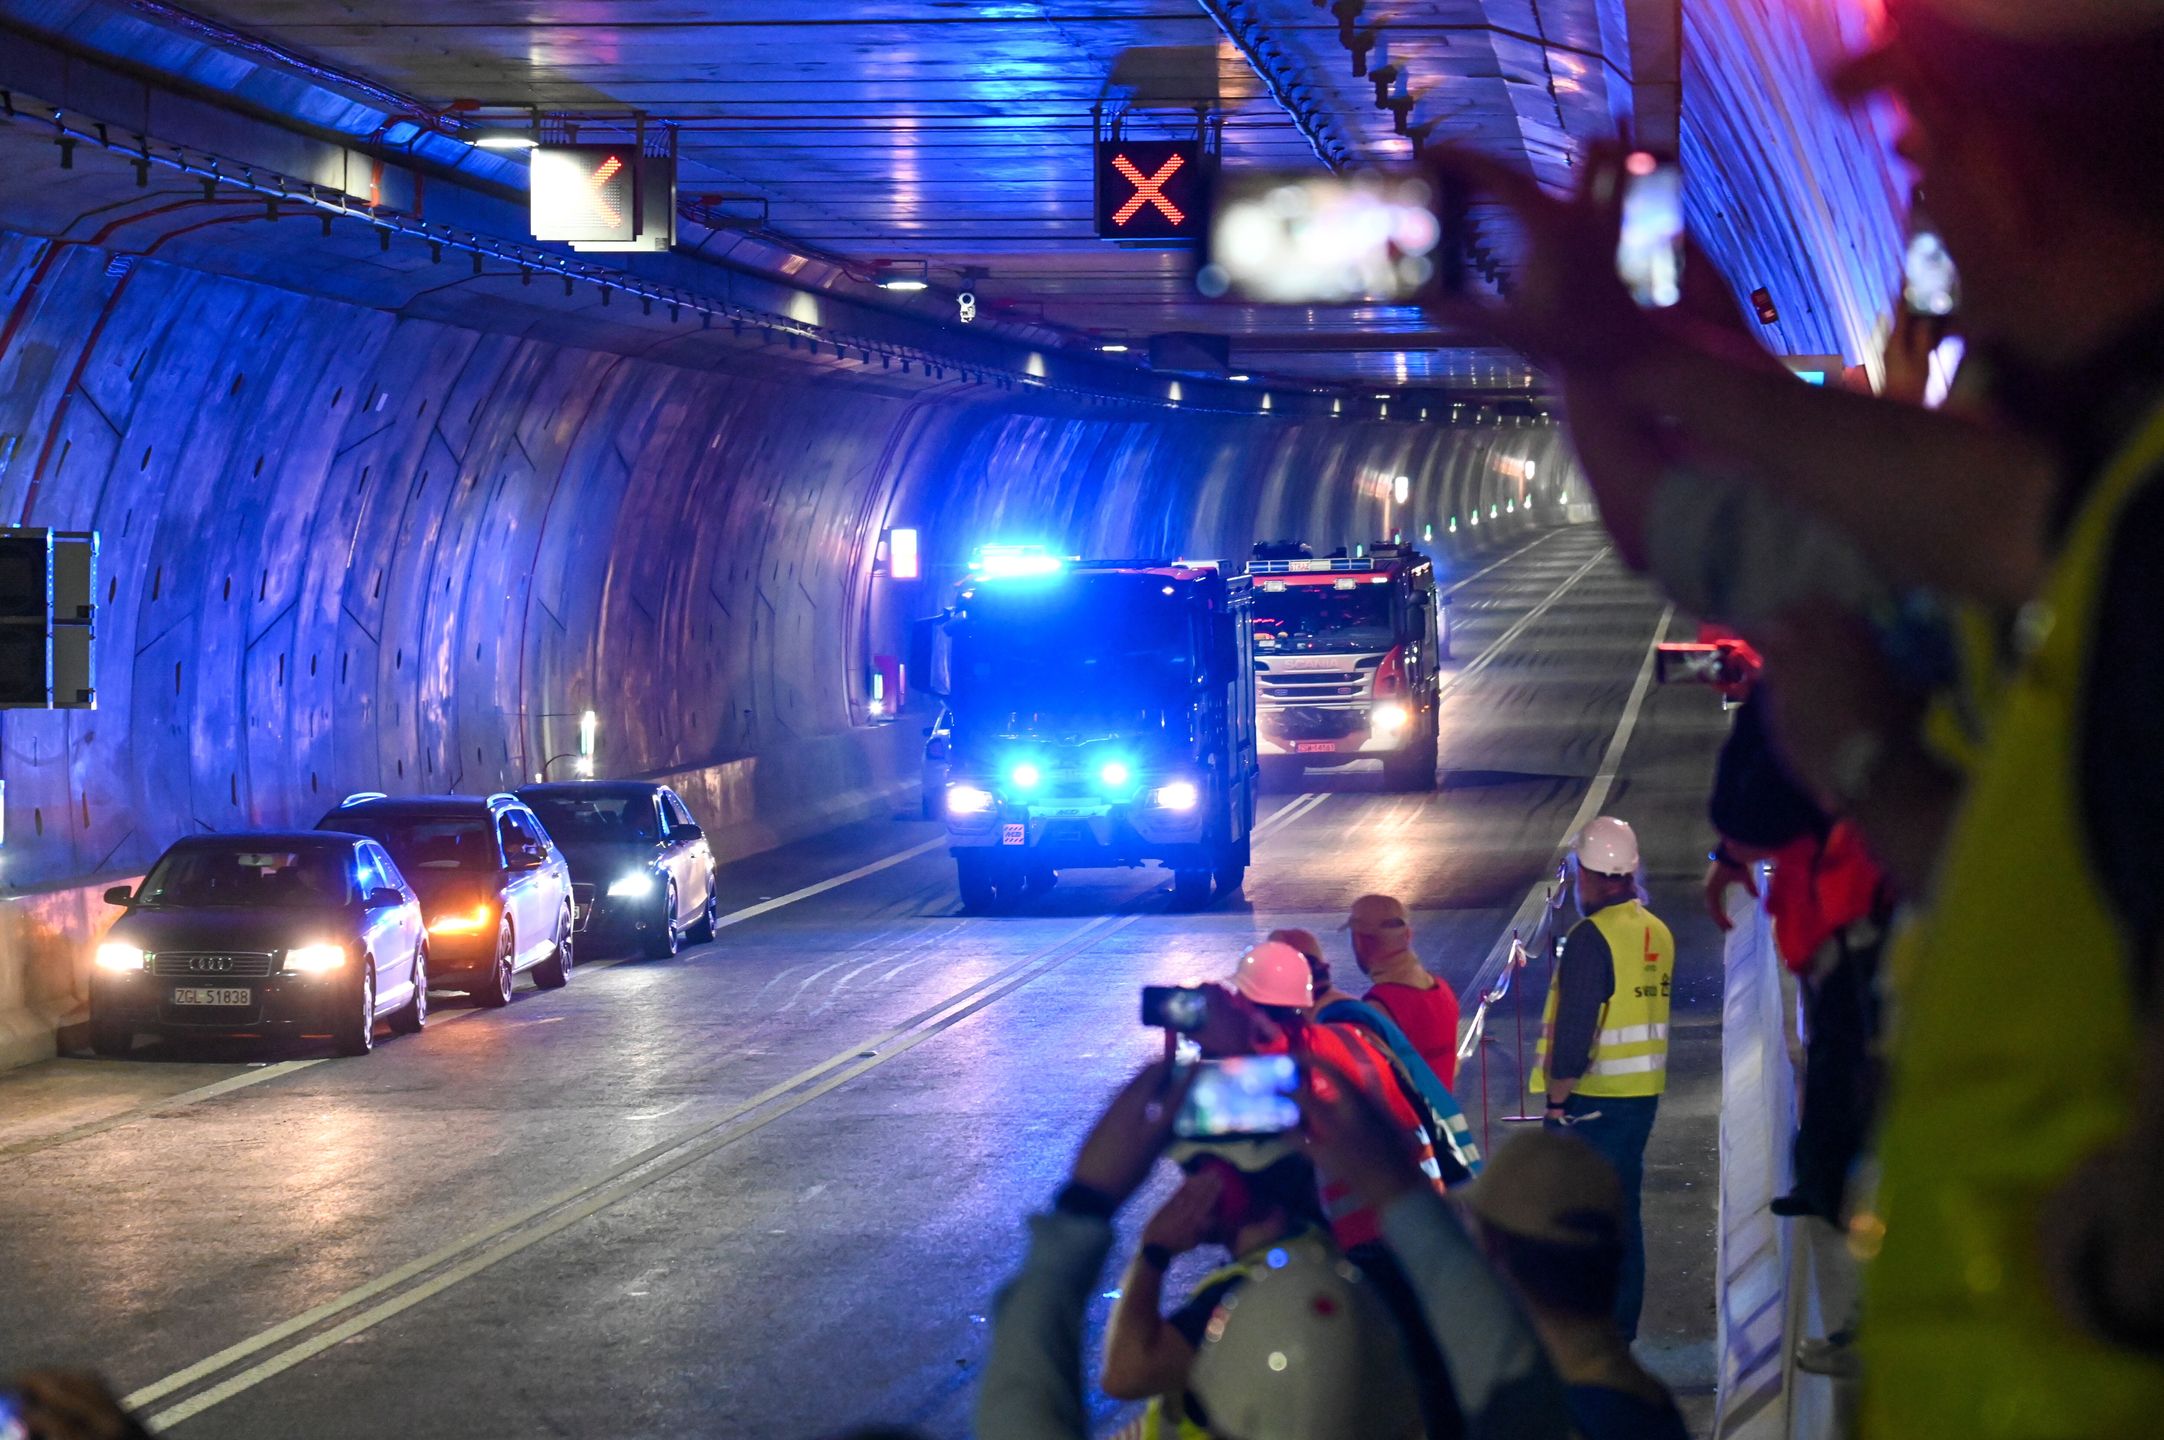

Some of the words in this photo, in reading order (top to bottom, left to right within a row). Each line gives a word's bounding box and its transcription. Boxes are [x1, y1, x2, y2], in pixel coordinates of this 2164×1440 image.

[1284, 659, 1339, 669] SCANIA
[176, 990, 202, 1004] ZGL
[206, 990, 249, 1004] 51838
